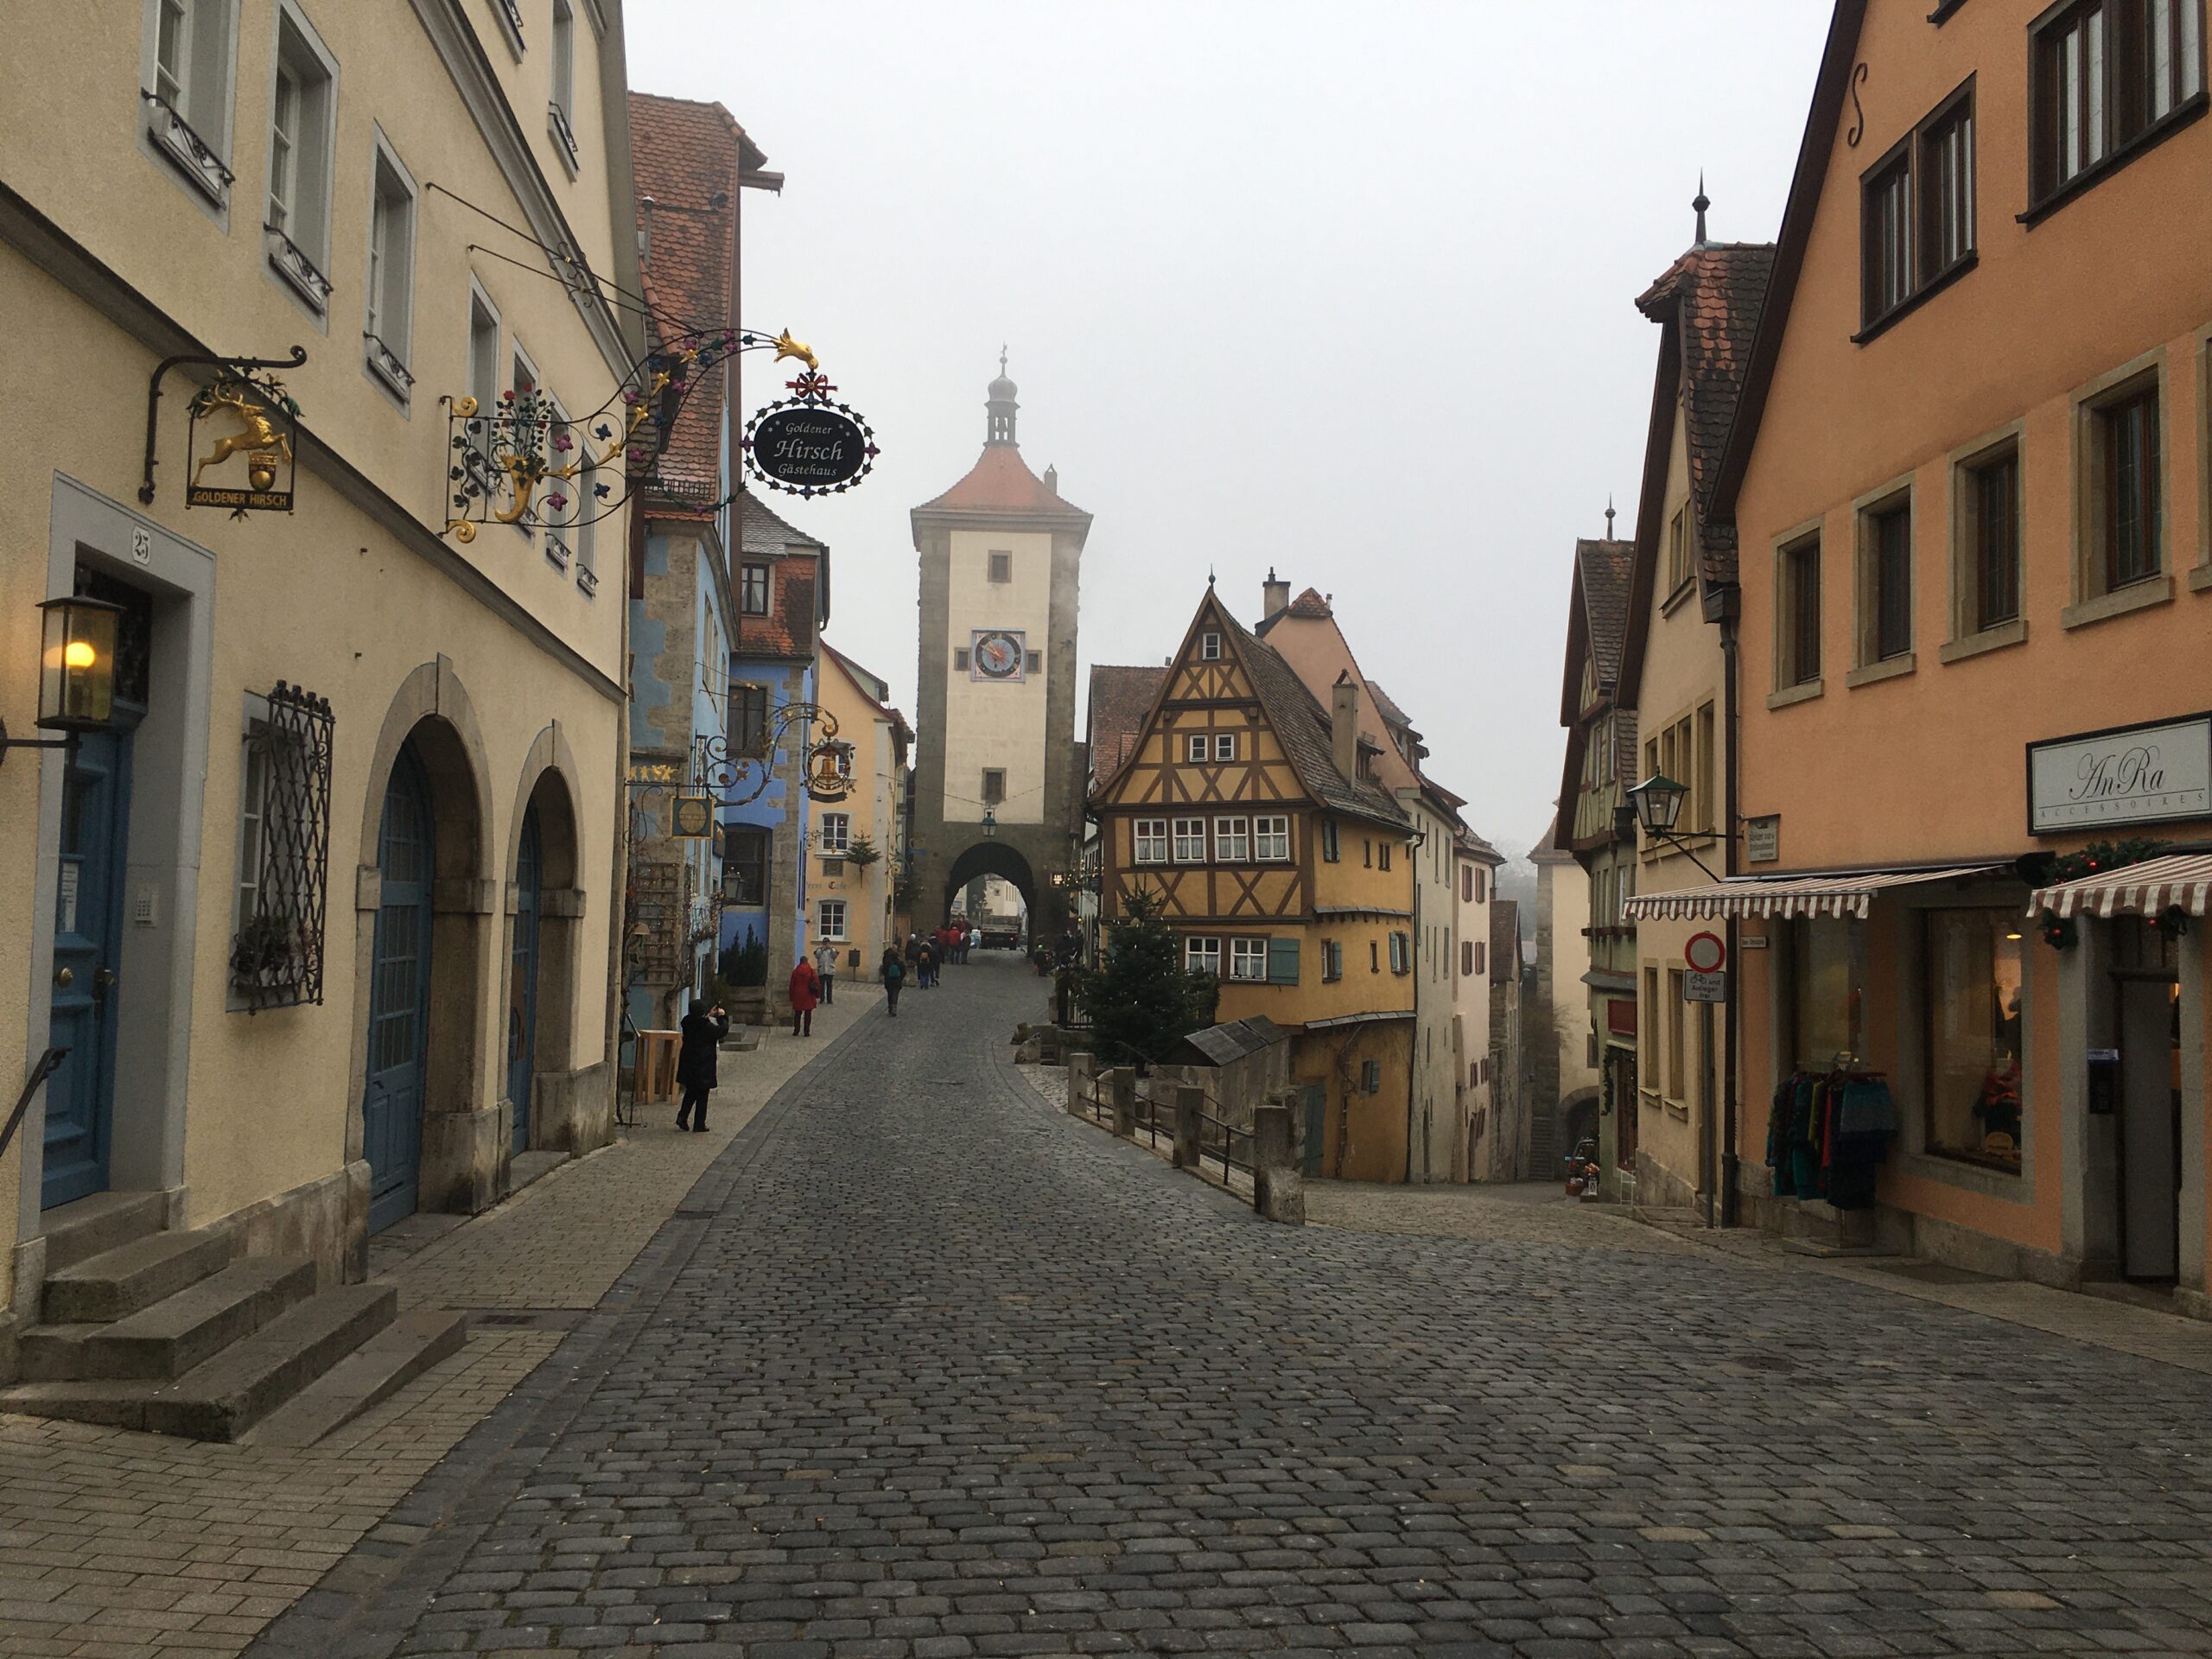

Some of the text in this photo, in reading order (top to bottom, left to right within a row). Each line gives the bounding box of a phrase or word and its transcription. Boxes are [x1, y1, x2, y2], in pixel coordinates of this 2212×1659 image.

[785, 422, 833, 435] Goldener
[773, 438, 843, 461] Hirsch
[778, 463, 837, 477] Gästehaus
[193, 491, 287, 506] GOLDENER HIRSCH
[134, 531, 149, 560] 25
[2040, 792, 2204, 818] ACCESSOIRES
